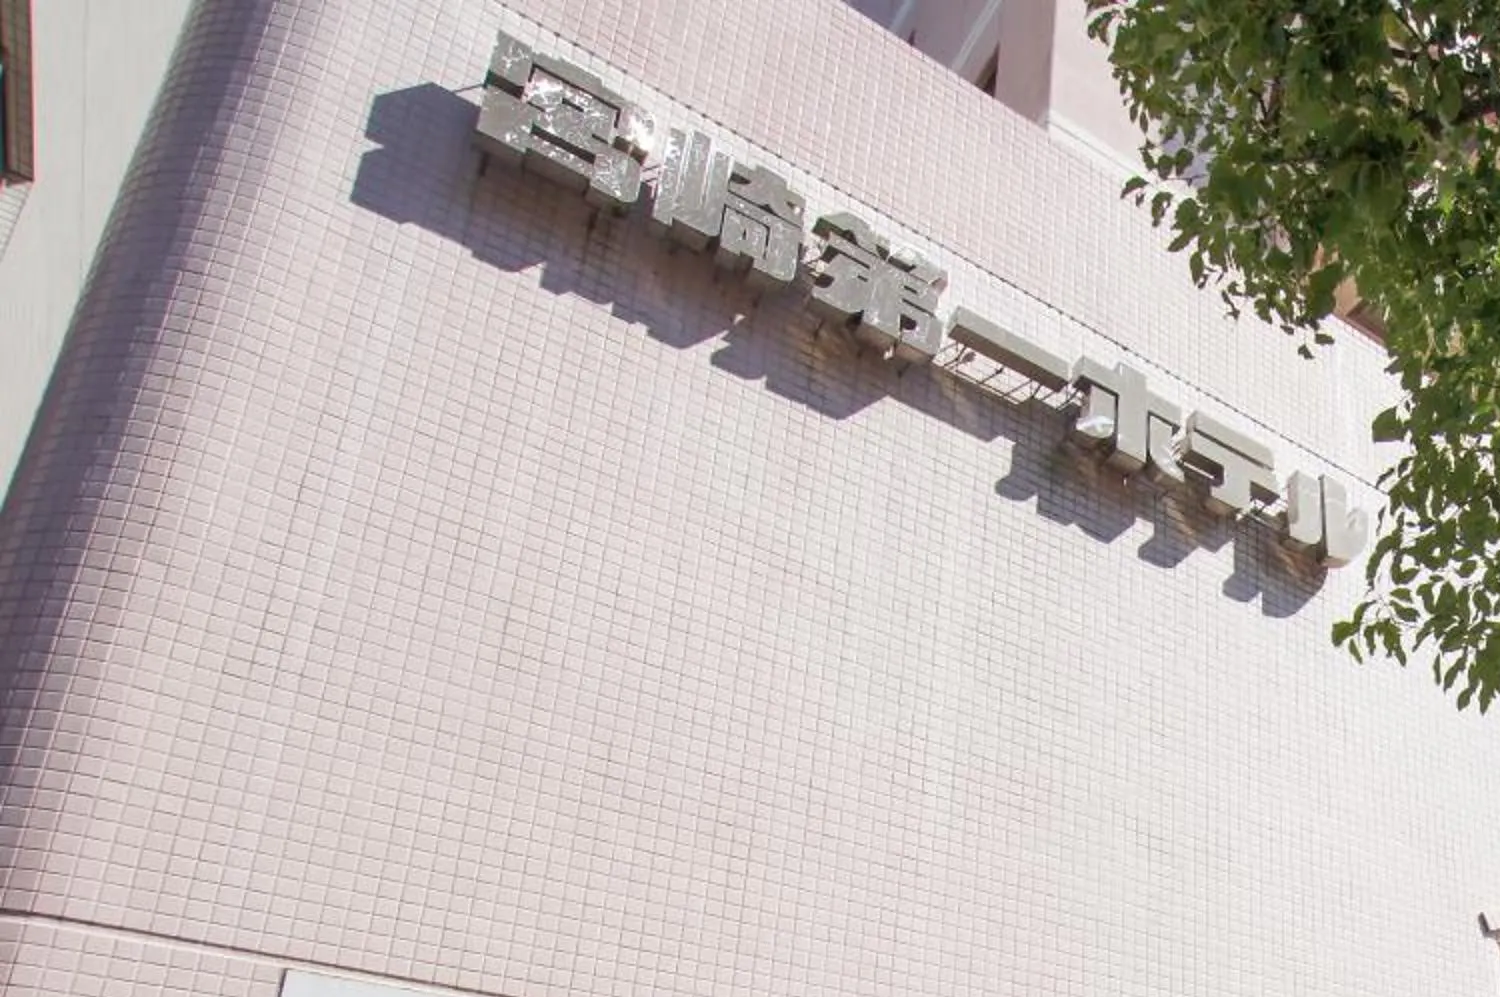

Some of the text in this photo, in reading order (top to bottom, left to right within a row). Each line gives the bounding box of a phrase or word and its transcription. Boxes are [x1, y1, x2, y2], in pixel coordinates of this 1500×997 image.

[475, 28, 1370, 570] 宮崎第一ホテル
